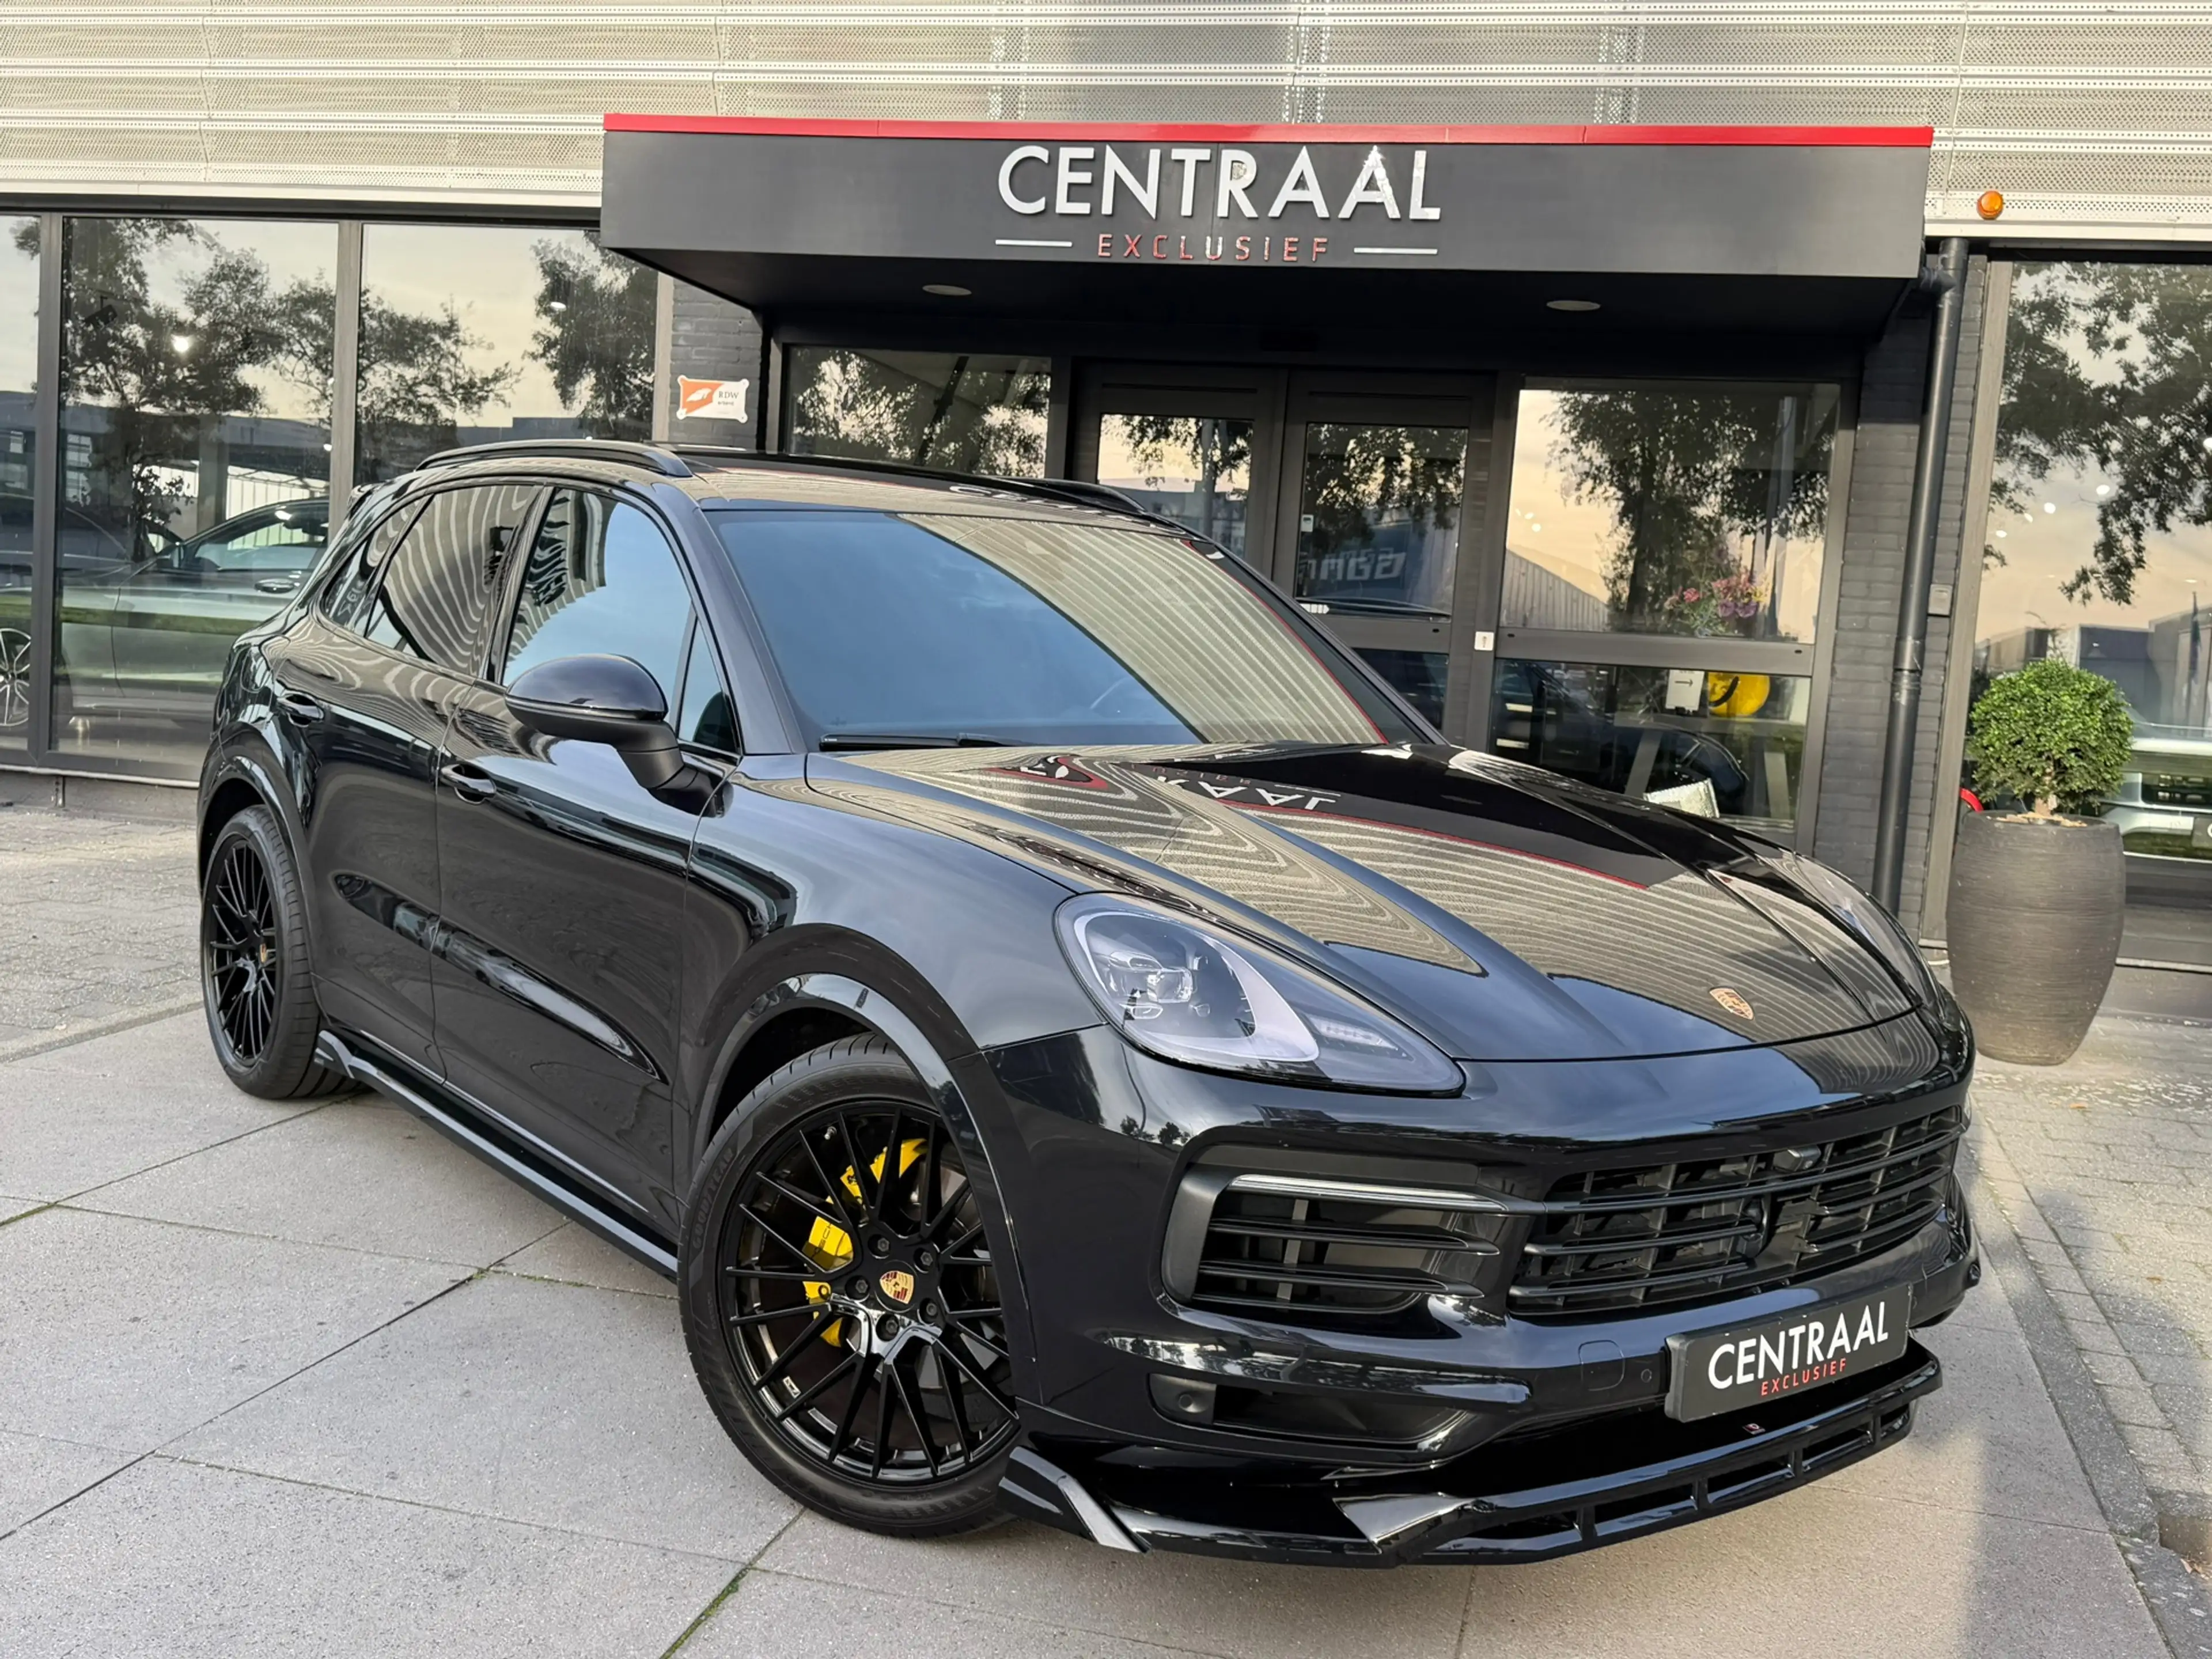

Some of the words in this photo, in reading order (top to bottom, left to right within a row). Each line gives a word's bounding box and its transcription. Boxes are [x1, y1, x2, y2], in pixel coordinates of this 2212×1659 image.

[998, 144, 1441, 220] CENTRAAL
[1097, 233, 1328, 262] EXCLUSIEF
[718, 391, 739, 399] RDW
[1708, 1301, 1889, 1389] CENTRAAL
[1760, 1357, 1847, 1396] EXCLUSIEF
